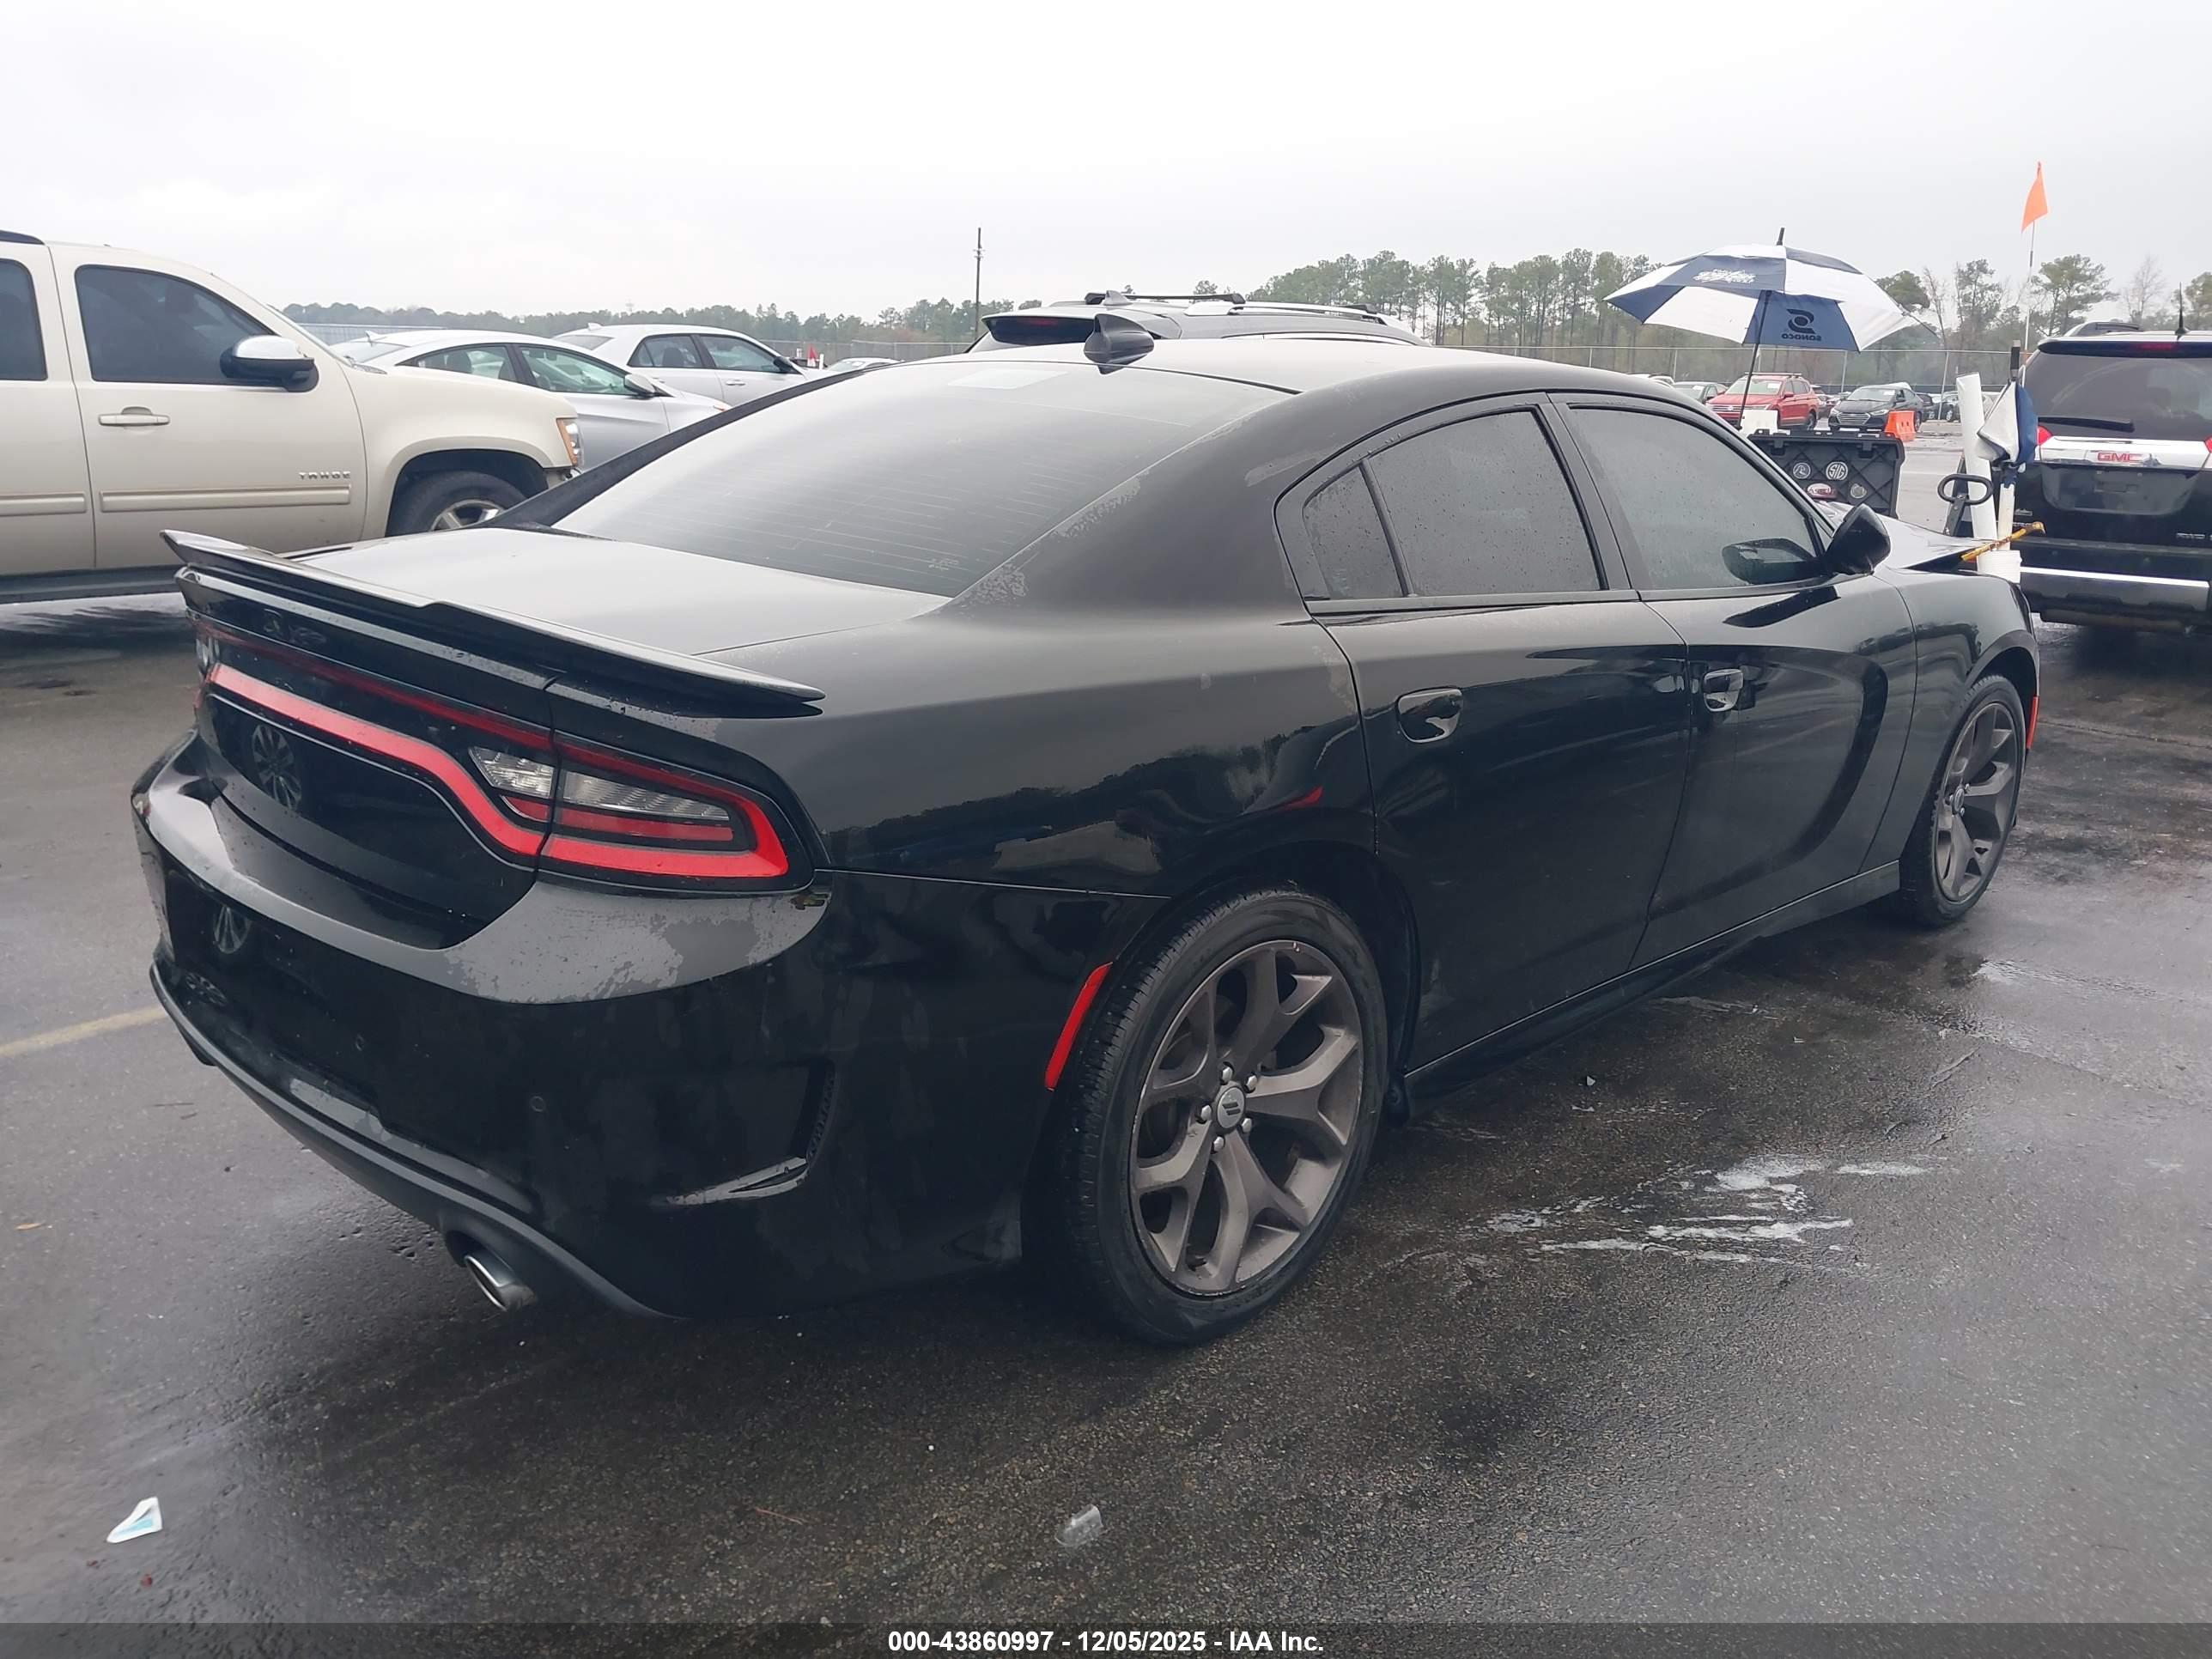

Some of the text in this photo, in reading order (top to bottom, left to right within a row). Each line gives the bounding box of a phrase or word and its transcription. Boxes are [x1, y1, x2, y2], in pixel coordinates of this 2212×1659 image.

[2098, 452, 2143, 462] GMC
[299, 471, 350, 480] TAHOE
[1827, 464, 1846, 479] SIG
